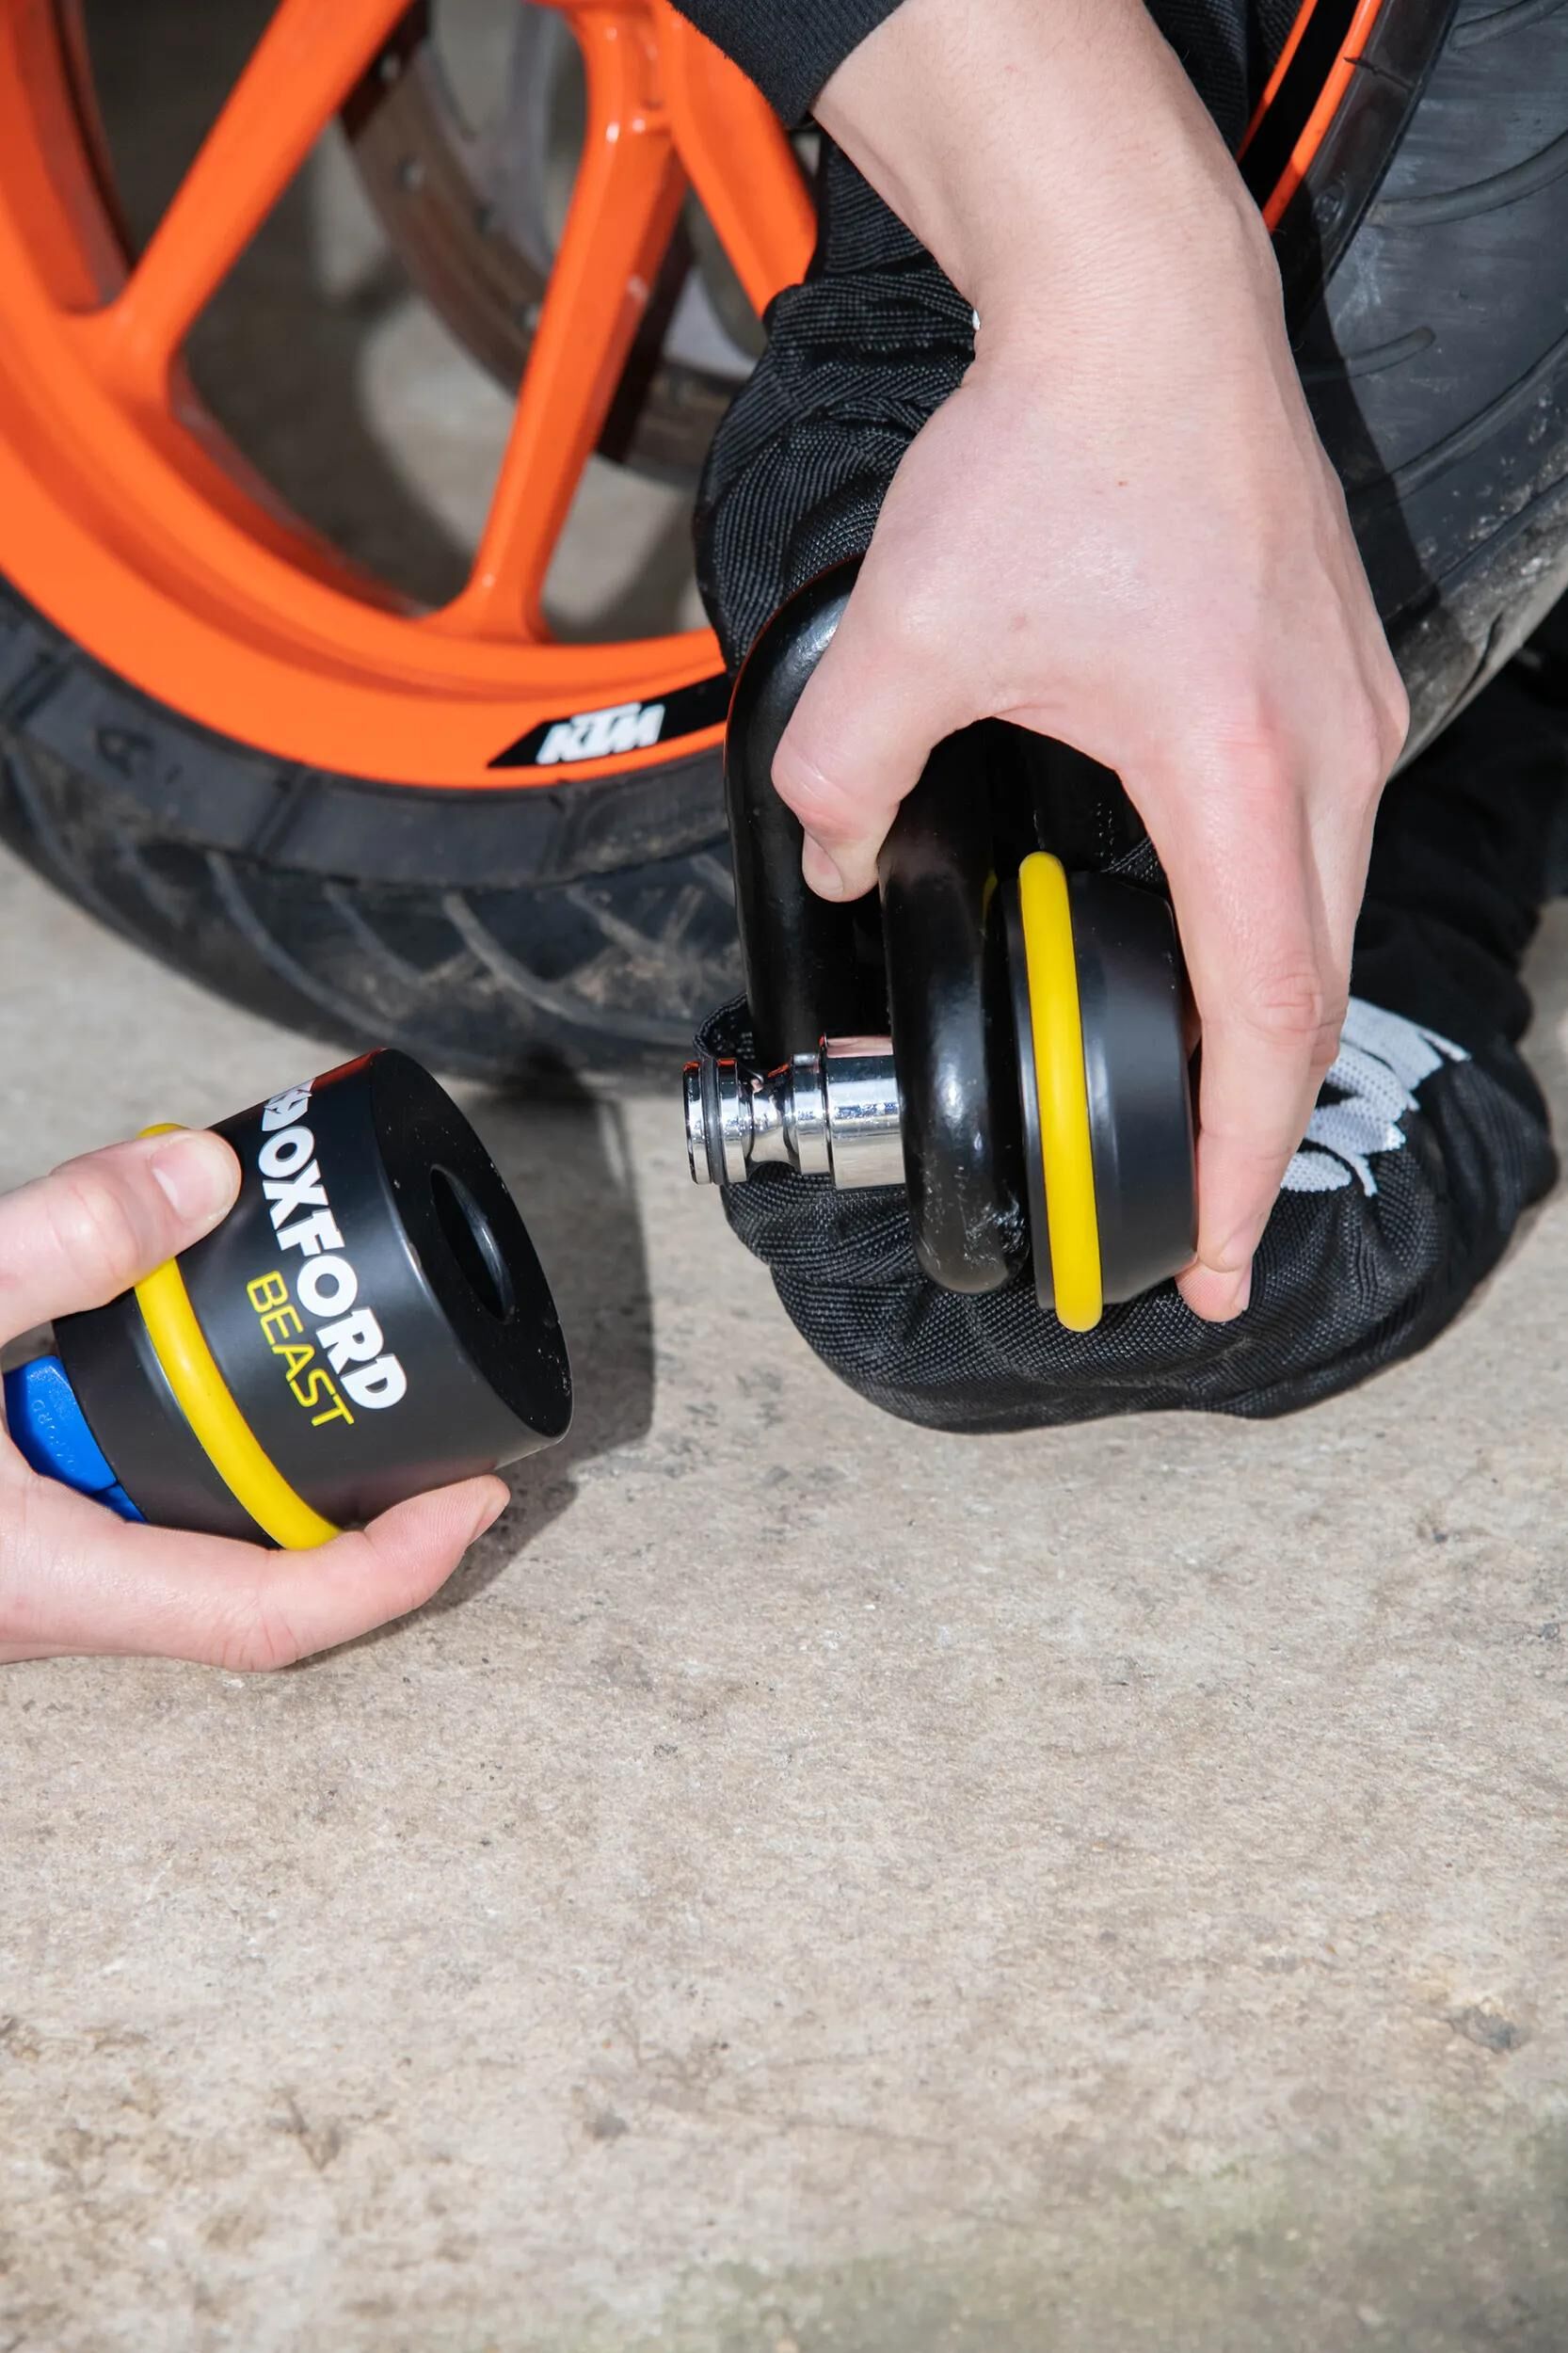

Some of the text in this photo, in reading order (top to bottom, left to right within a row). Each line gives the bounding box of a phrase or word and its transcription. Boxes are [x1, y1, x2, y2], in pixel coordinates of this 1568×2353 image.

[536, 701, 665, 764] KTM
[258, 1126, 408, 1410] OXFORD
[246, 1271, 355, 1427] BEAST
